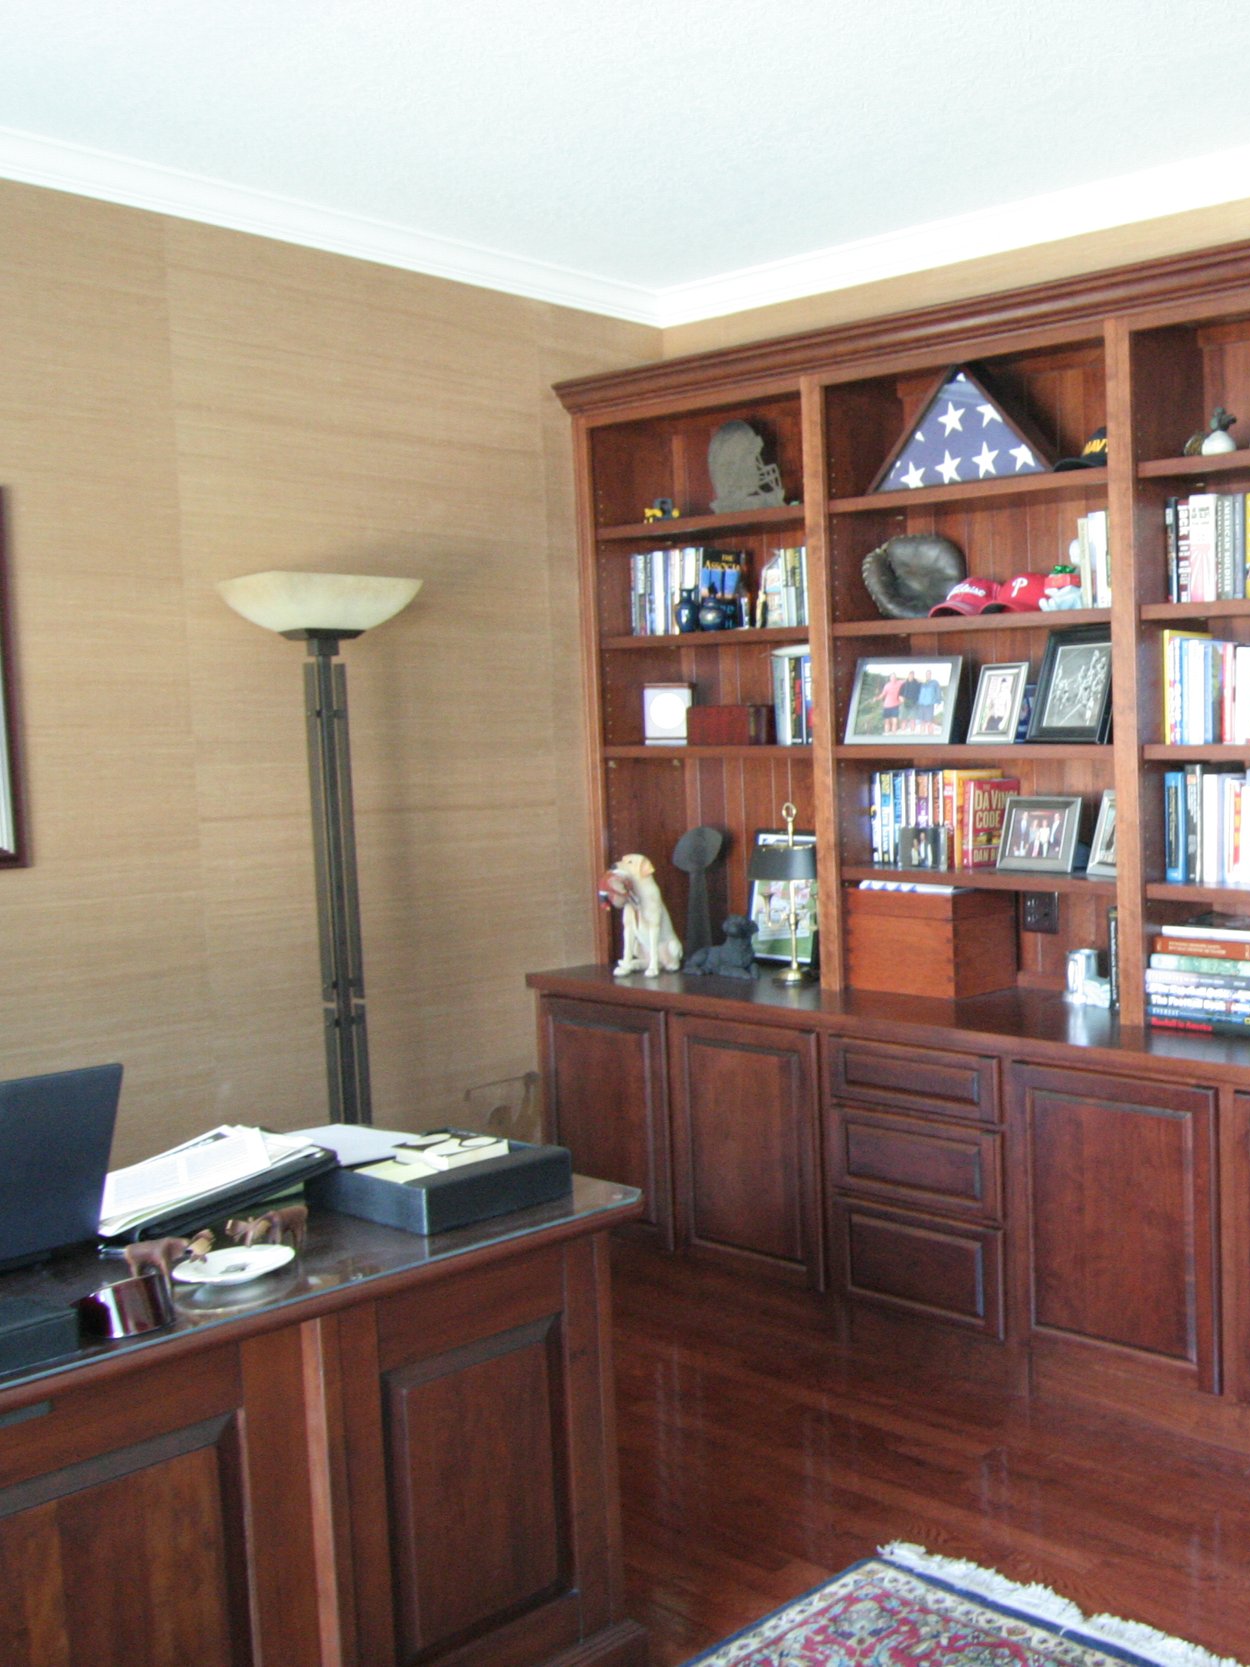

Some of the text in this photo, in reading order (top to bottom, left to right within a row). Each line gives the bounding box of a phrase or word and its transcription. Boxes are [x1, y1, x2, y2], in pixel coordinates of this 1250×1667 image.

[704, 560, 741, 571] ASSOCIA
[974, 790, 990, 810] DA
[991, 789, 1018, 810] VIN
[976, 811, 1001, 829] CODE
